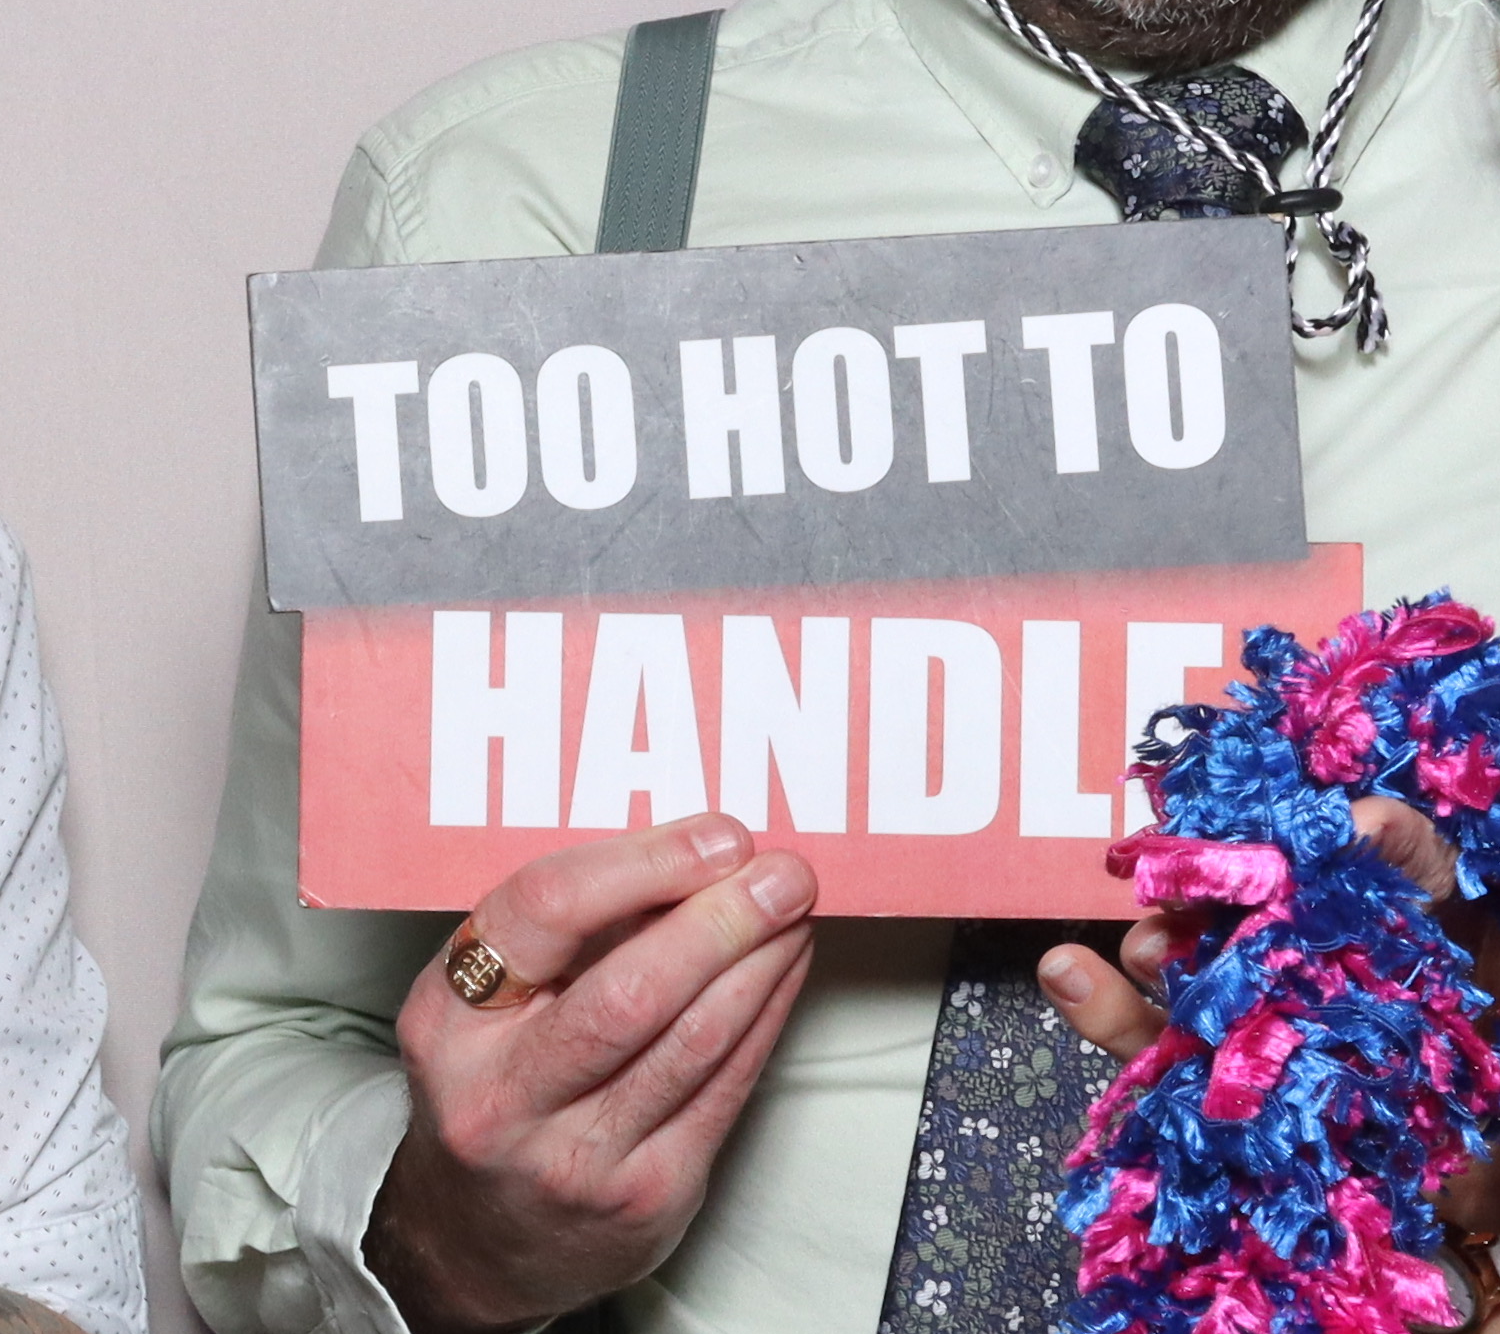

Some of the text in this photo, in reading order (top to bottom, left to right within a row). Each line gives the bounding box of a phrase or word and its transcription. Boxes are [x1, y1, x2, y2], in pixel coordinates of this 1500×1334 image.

[326, 302, 1227, 523] TOO HOT TO
